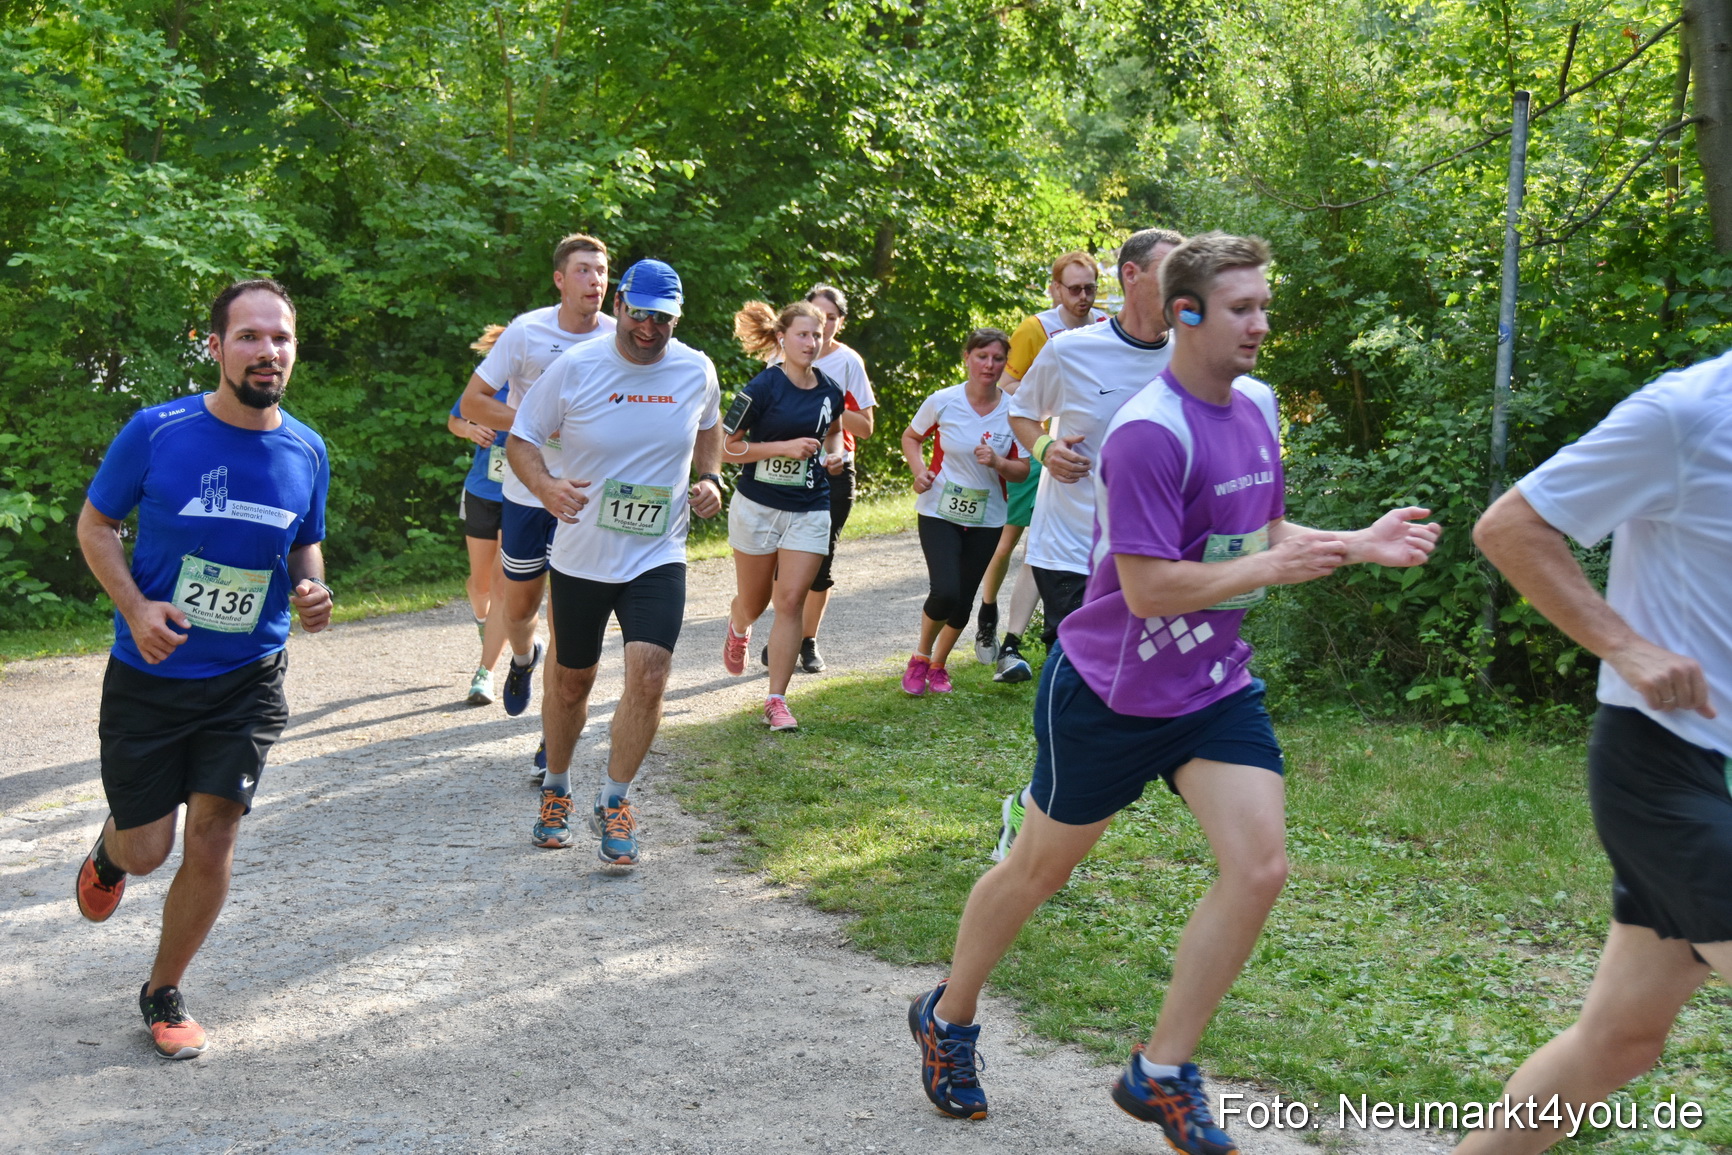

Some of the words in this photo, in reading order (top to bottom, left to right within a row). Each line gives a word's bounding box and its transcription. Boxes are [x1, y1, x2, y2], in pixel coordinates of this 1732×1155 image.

[626, 395, 678, 404] KLEBL
[168, 408, 186, 417] JAKO
[764, 458, 801, 475] 1952
[610, 499, 662, 523] 1177
[949, 497, 978, 514] 355
[231, 510, 263, 520] Neumarkt
[184, 583, 254, 615] 2136
[192, 607, 214, 618] Kreml
[215, 613, 242, 622] Manfred
